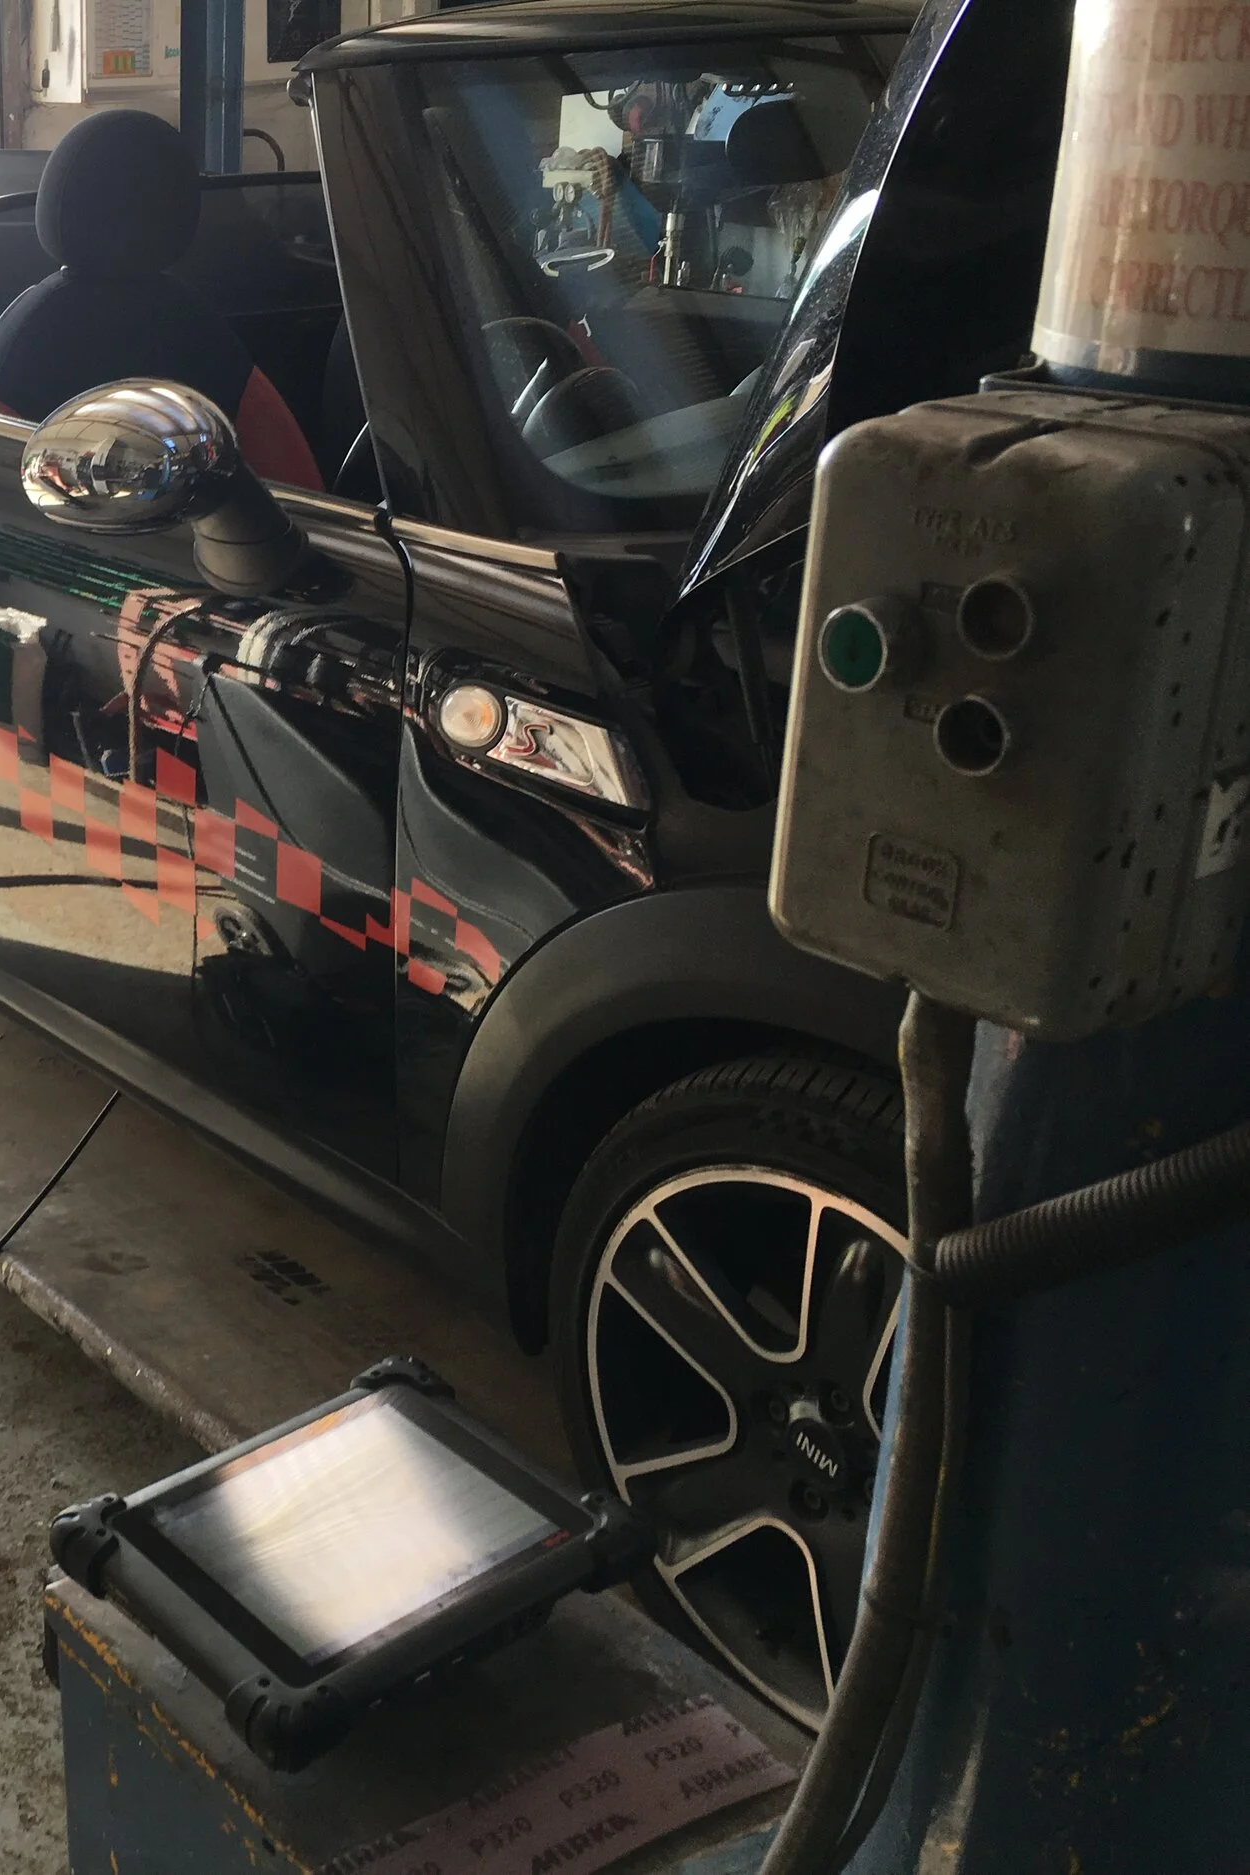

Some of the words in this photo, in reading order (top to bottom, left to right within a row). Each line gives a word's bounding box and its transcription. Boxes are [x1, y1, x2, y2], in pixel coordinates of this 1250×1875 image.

[795, 1431, 839, 1479] MINI
[468, 1815, 534, 1858] P320
[558, 1769, 622, 1810] P320
[645, 1736, 704, 1770] P320
